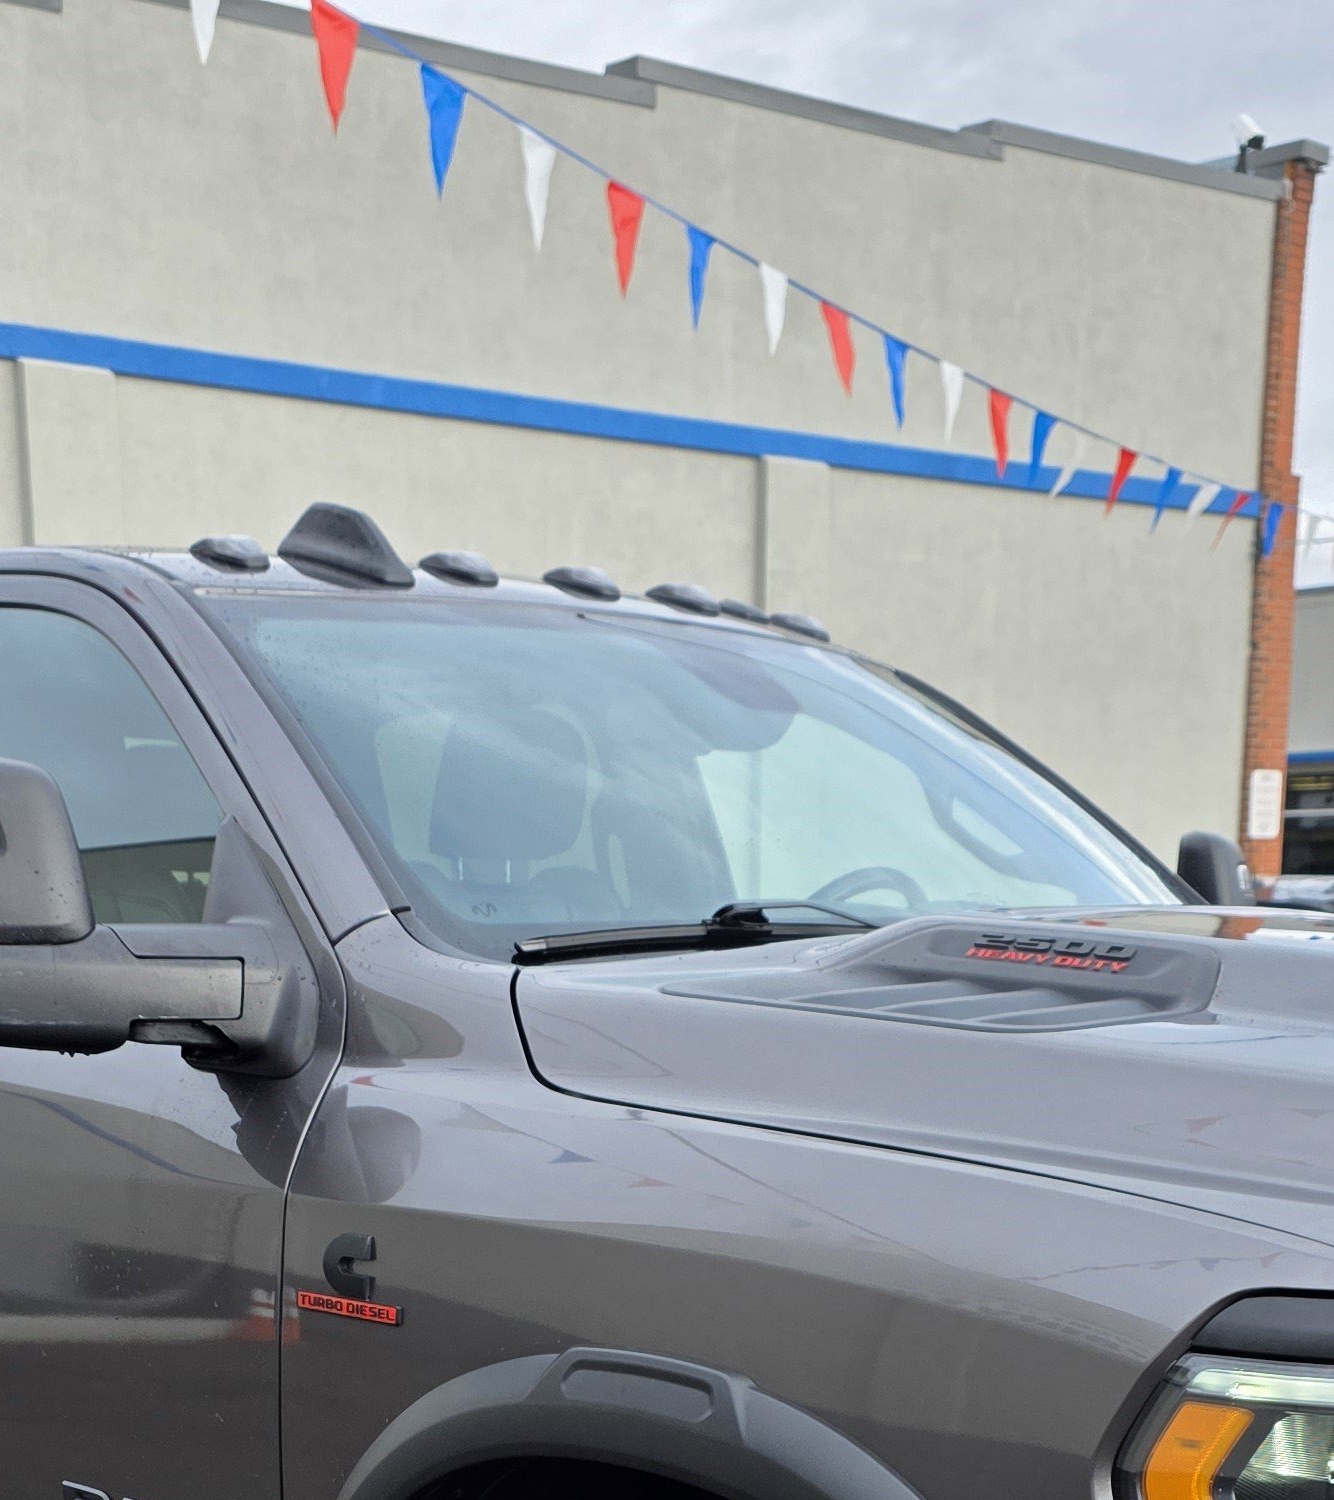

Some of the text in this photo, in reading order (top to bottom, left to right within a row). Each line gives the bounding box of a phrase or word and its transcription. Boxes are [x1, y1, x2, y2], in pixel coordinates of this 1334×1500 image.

[965, 946, 1131, 974] HEAVY DUTY
[299, 1293, 395, 1321] TURBO DIESEL
